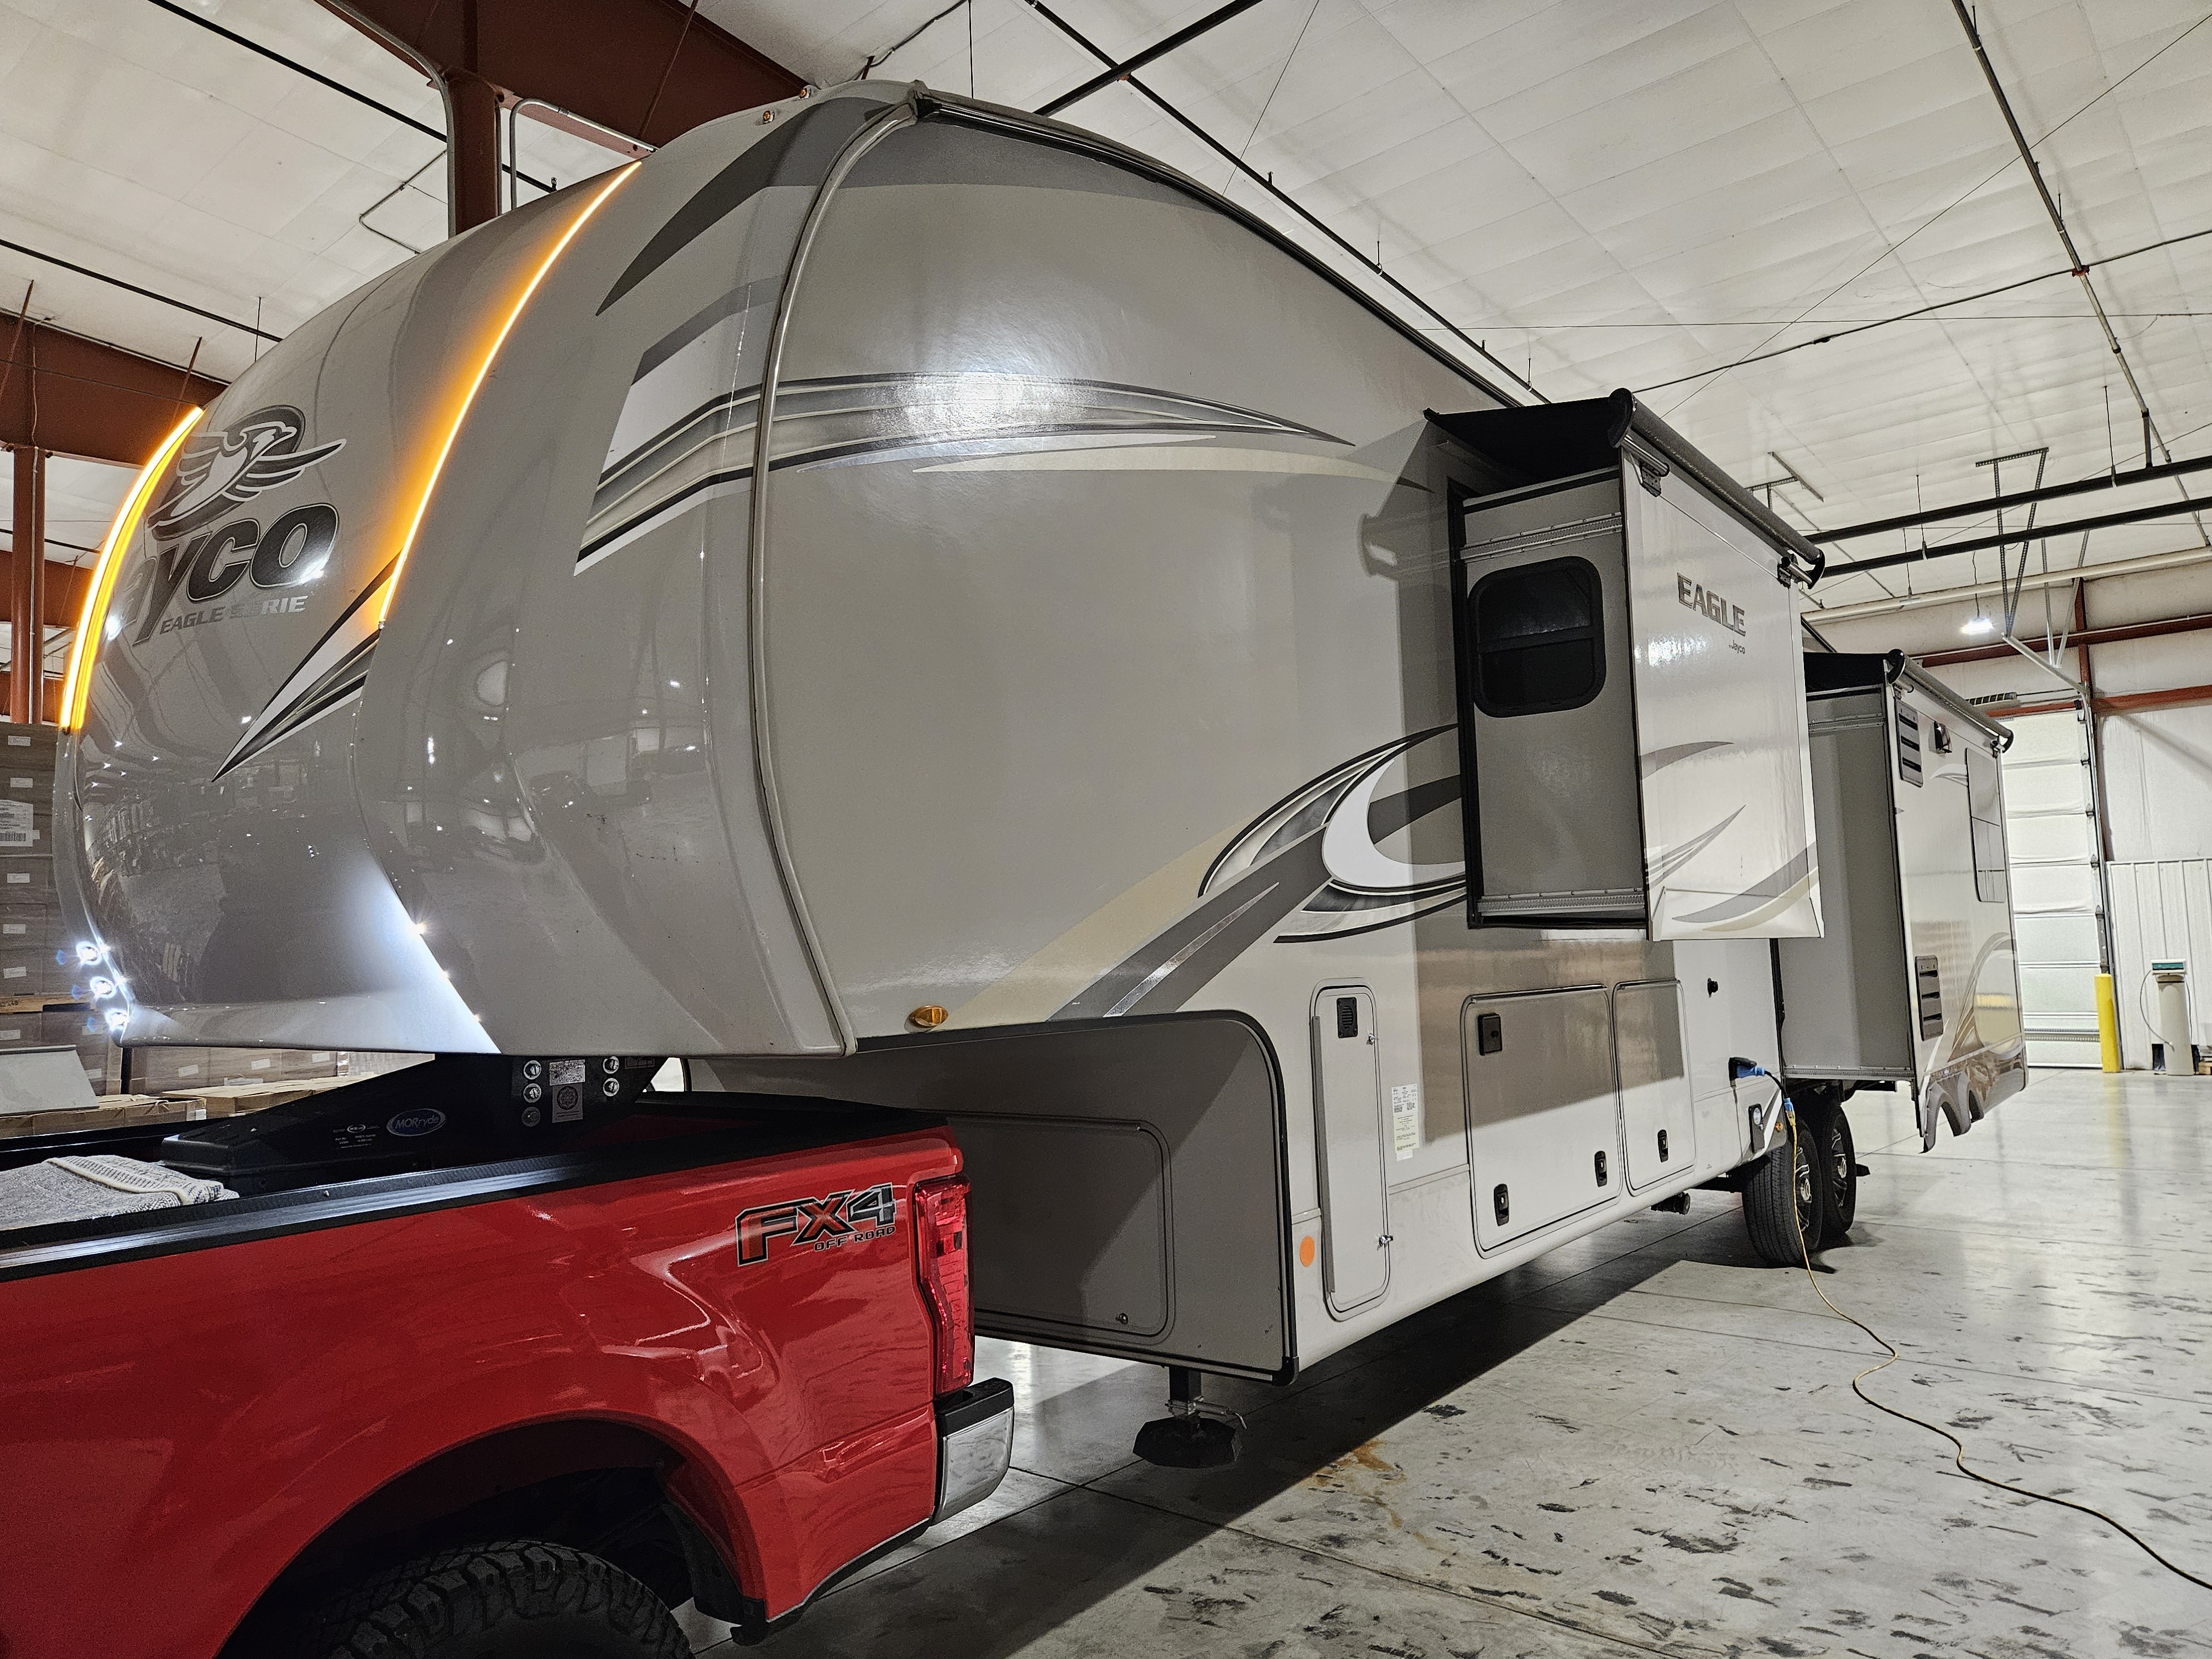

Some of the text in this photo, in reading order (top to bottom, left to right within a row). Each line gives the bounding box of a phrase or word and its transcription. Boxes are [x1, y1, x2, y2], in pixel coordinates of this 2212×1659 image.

[1677, 572, 1746, 637] EAGLE
[159, 606, 226, 635] EAGLE
[394, 1114, 440, 1130] MORryde
[735, 1182, 896, 1267] FX4
[813, 1225, 896, 1253] OFF ROAD
